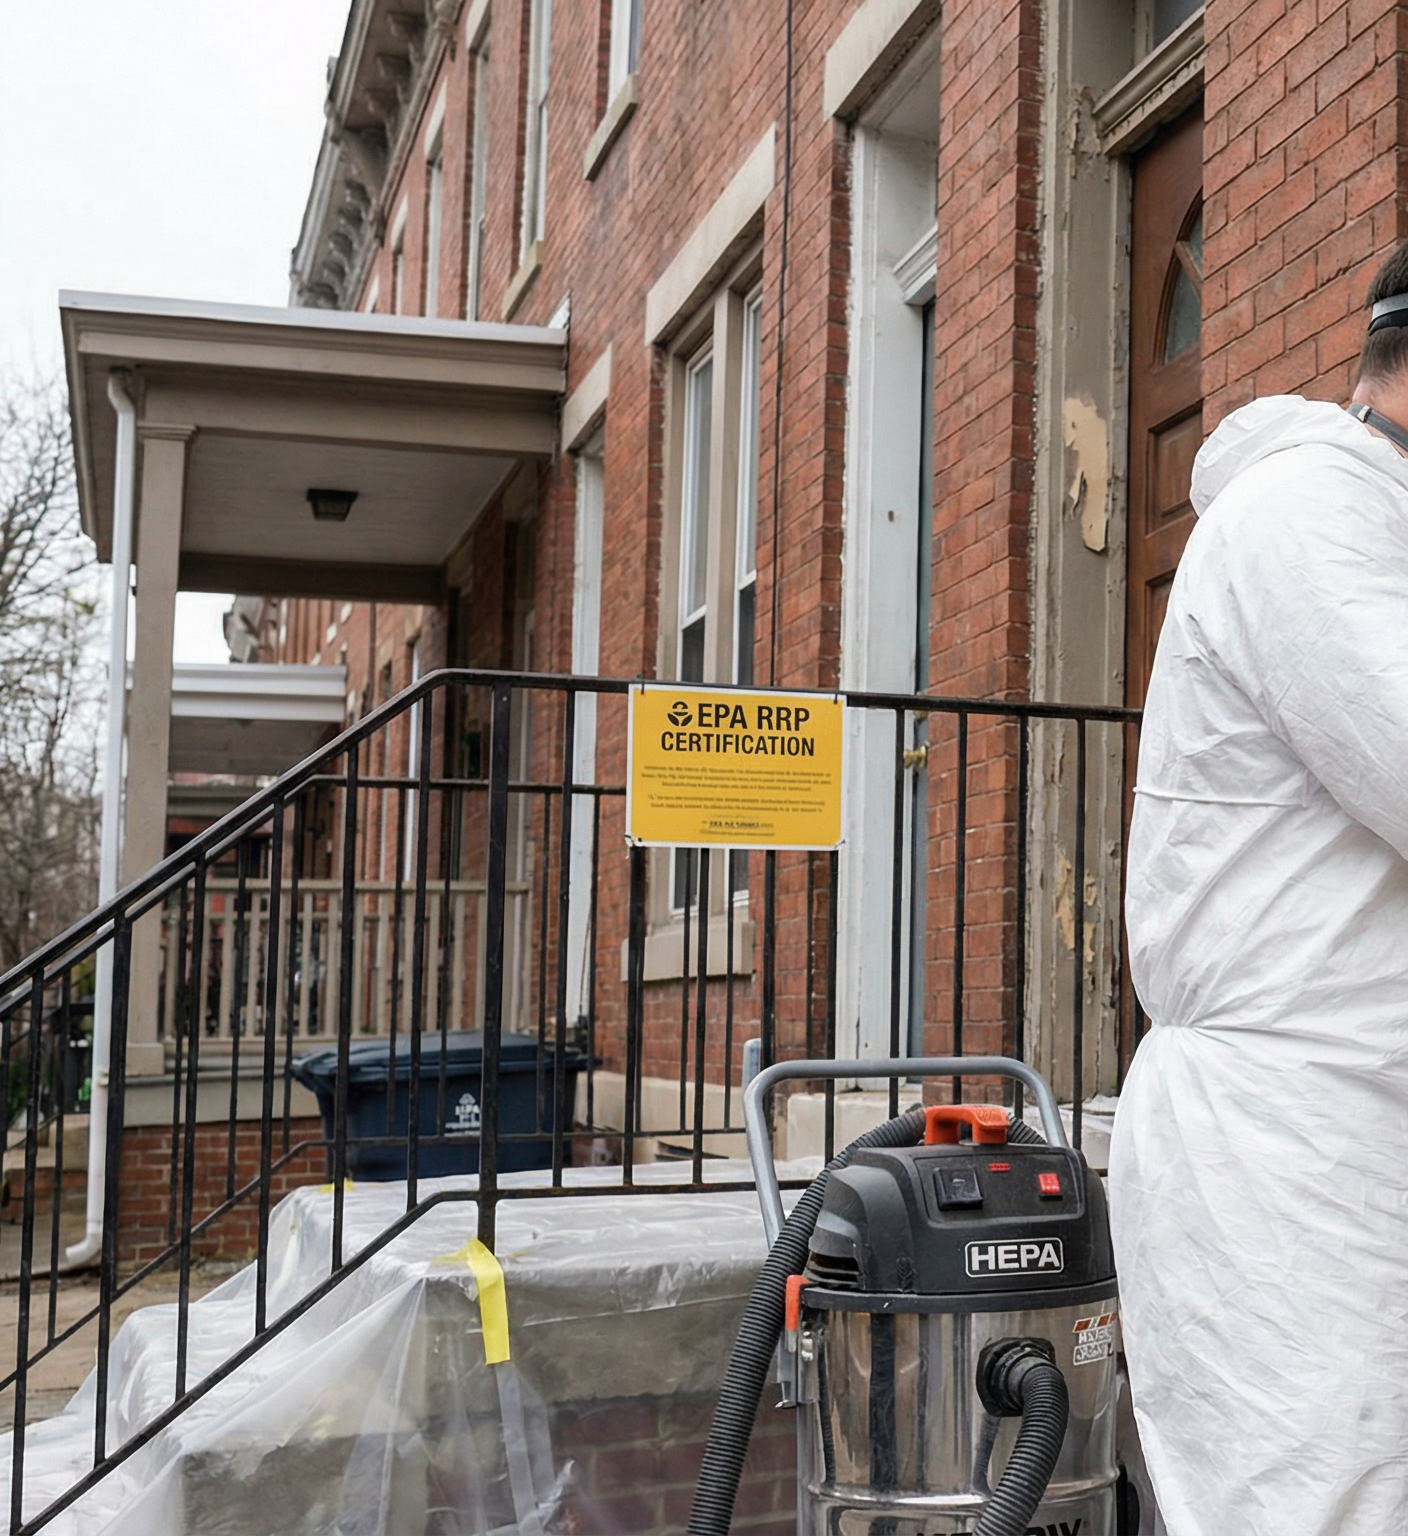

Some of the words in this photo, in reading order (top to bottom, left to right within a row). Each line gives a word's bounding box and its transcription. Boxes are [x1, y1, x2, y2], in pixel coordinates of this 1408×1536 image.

[697, 703, 748, 729] EPA
[757, 705, 810, 731] RRP
[661, 731, 814, 756] CERTIFICATION
[971, 1242, 1061, 1271] HEPA
